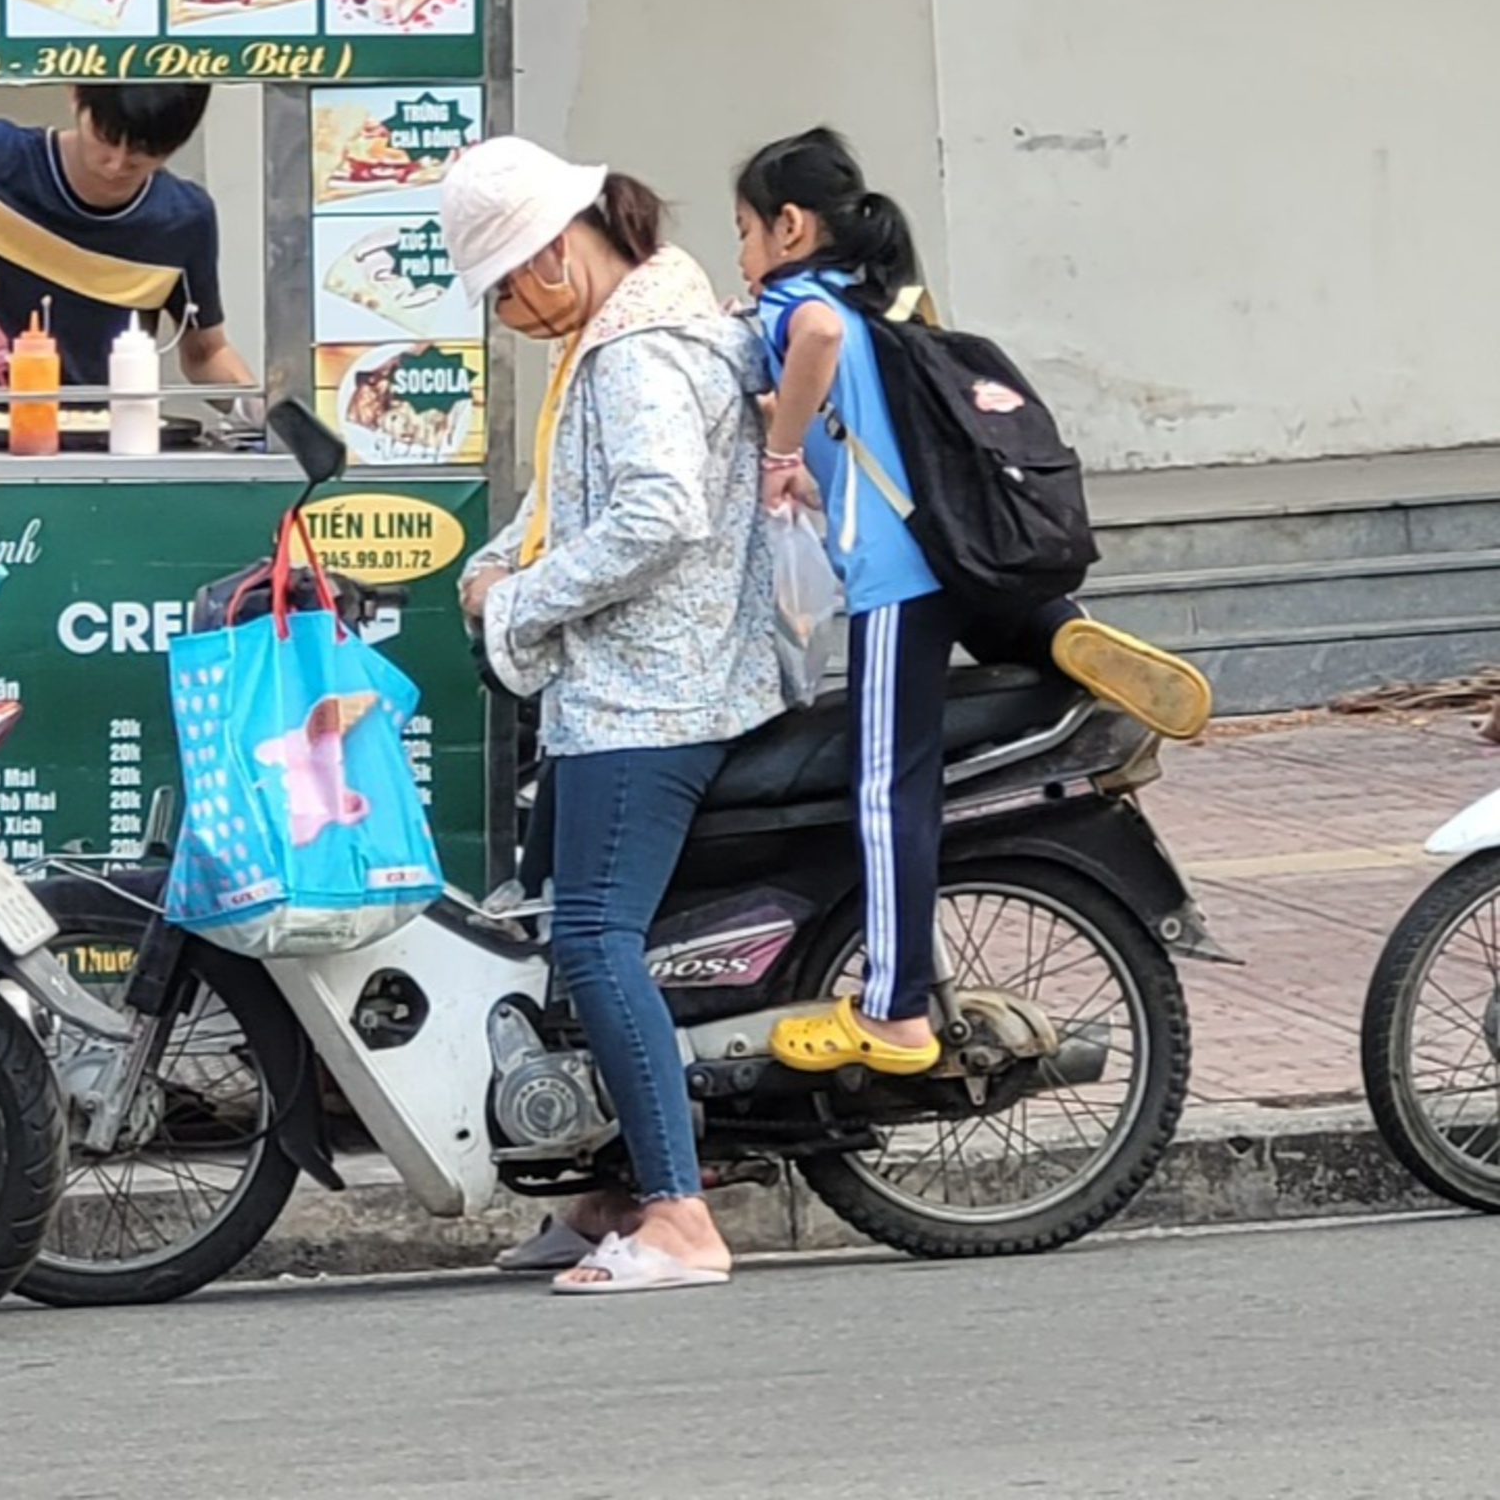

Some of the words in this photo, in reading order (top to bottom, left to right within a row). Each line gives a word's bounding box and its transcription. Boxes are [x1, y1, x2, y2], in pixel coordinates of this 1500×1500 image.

[32, 43, 107, 76] 30k
[241, 42, 326, 80] Biệt
[394, 368, 470, 393] SOCOLA
[306, 503, 363, 539] TIẾN
[374, 513, 432, 539] LINH
[318, 550, 432, 569] 345.99.01.72
[57, 601, 194, 654] CRE
[109, 718, 141, 739] 20k
[109, 743, 141, 762] 20k
[109, 767, 141, 786] 20k
[109, 791, 141, 810] 20k
[109, 815, 141, 834] 20k
[649, 957, 751, 978] BOSS
